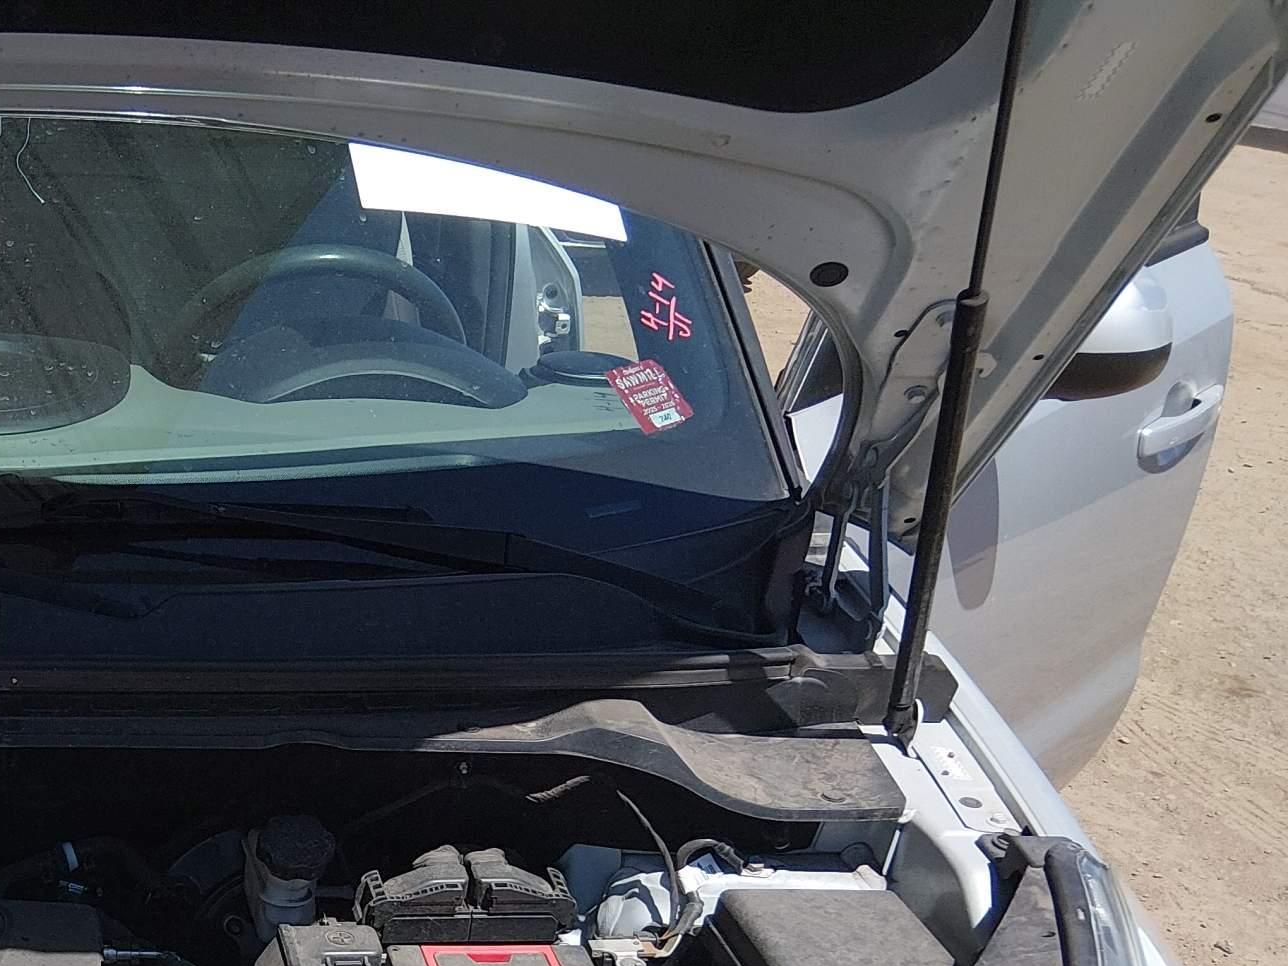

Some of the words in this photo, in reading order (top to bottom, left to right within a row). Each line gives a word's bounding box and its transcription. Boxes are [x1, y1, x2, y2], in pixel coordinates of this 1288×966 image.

[640, 272, 675, 330] 4-14
[633, 386, 666, 401] PARKING
[641, 393, 668, 407] PERMIT
